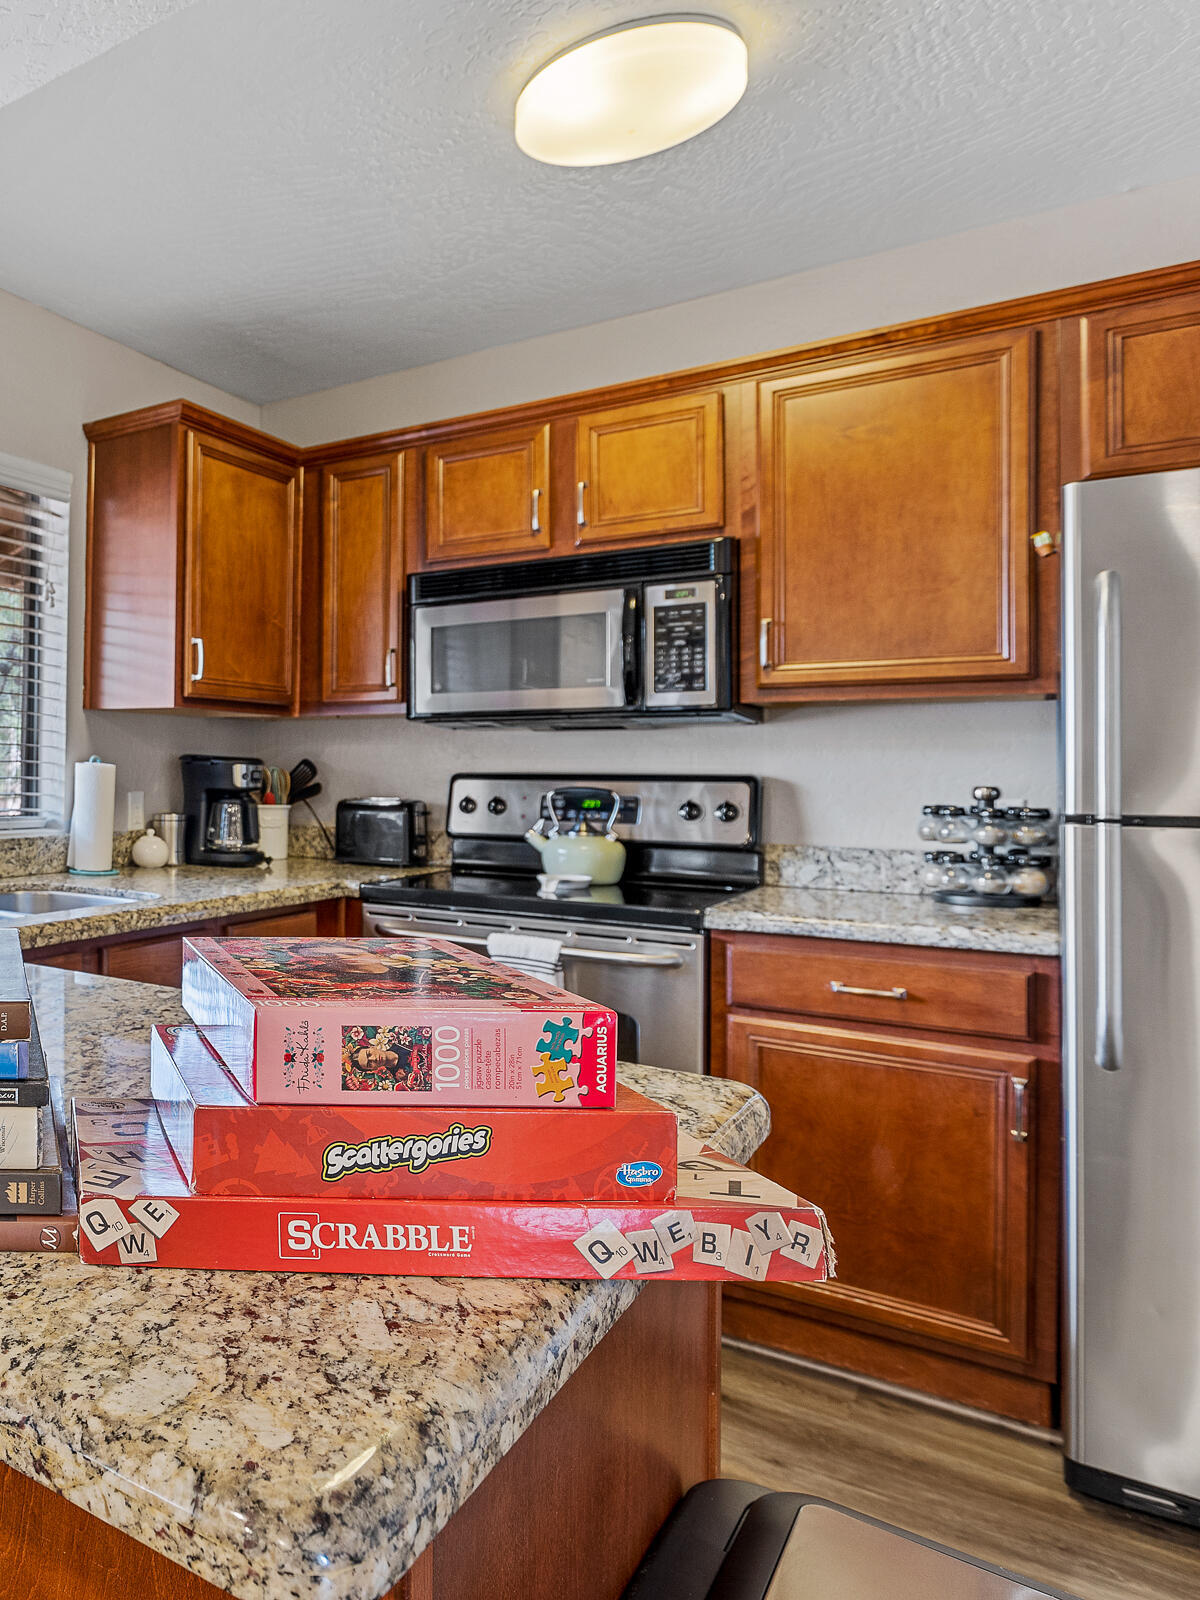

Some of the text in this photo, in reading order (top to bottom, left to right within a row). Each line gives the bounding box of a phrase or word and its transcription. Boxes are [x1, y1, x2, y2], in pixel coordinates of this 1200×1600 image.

[296, 1054, 310, 1094] Frida
[434, 1025, 461, 1091] 1000
[474, 1039, 484, 1090] jigsaw puzzle
[493, 1028, 503, 1089] rompecabezas
[596, 1026, 608, 1094] AQUARIUS
[325, 1125, 489, 1177] Scattergories
[617, 1164, 659, 1177] Hasbro
[29, 1181, 38, 1205] Harper
[287, 1219, 472, 1252] SCRABBLE
